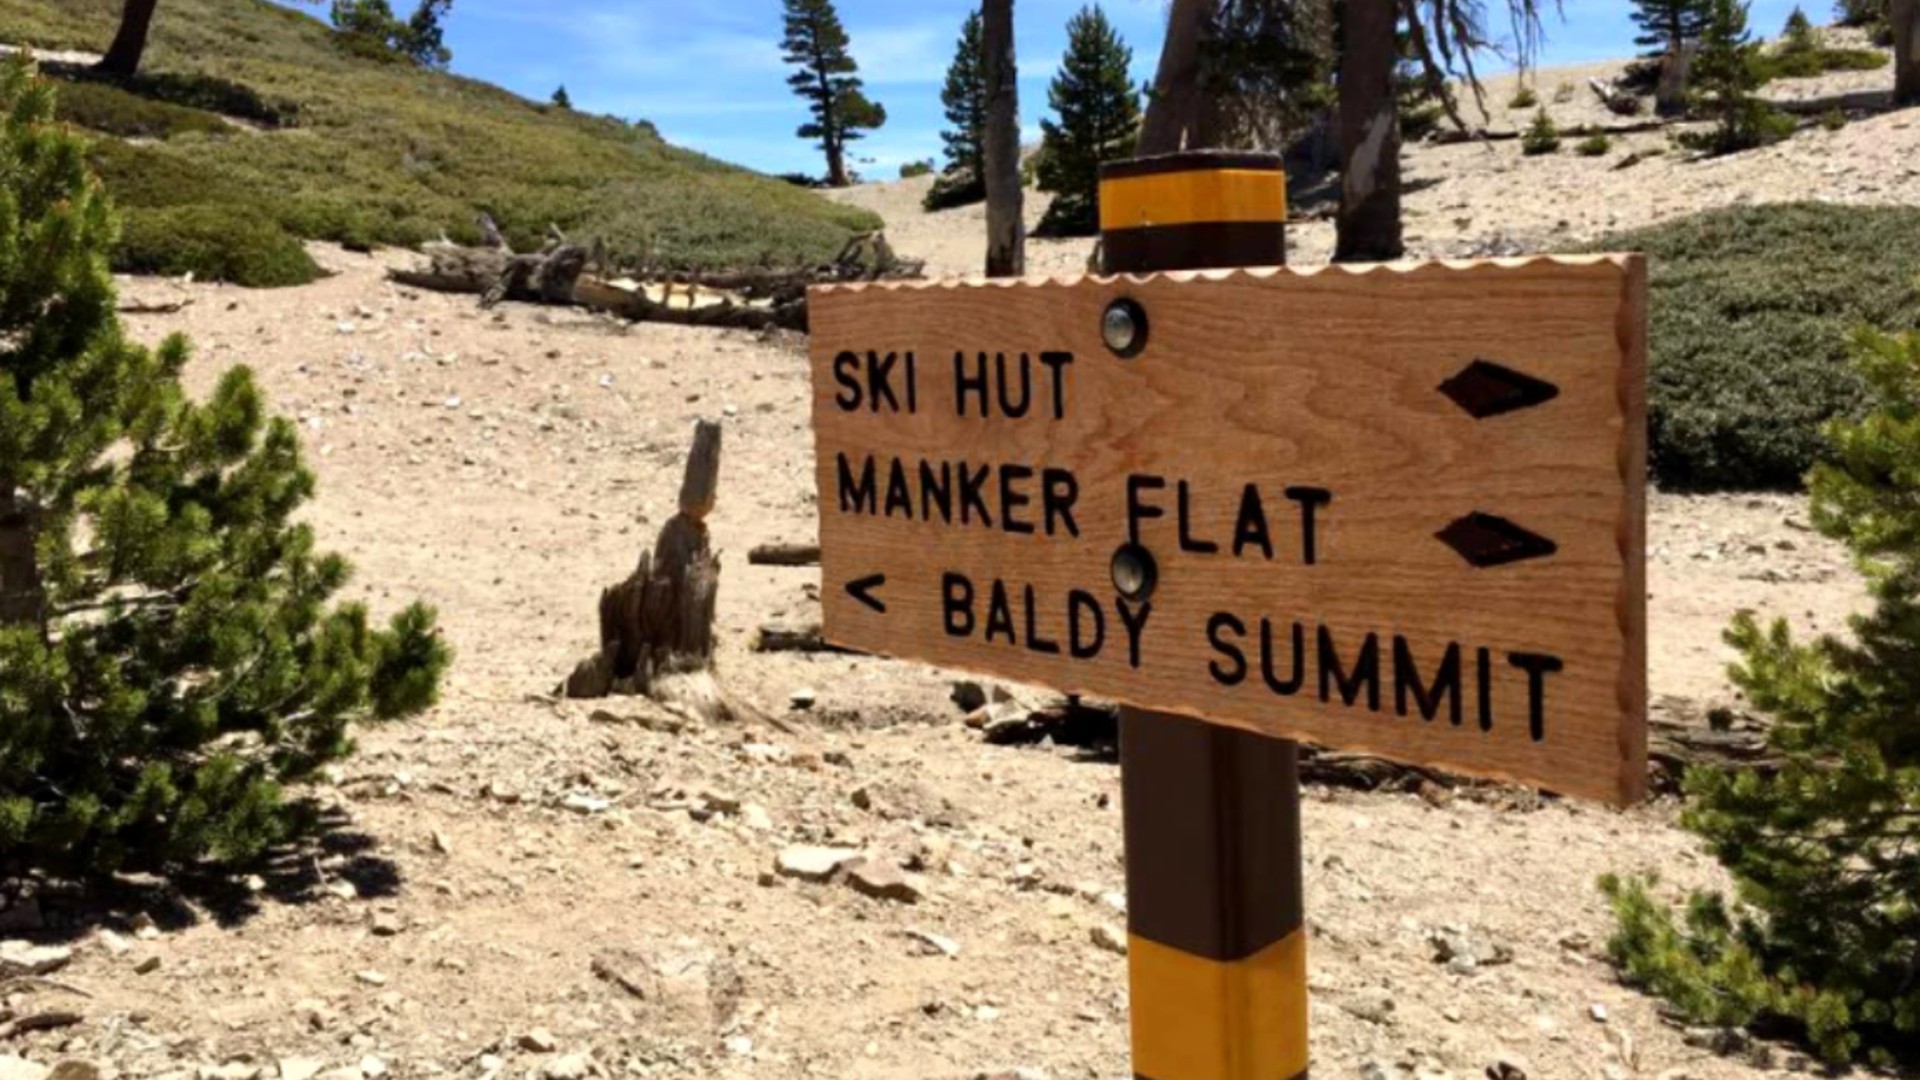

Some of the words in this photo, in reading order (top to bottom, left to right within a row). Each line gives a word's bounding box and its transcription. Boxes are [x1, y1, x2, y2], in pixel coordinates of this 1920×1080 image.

[832, 349, 917, 415] SKI
[952, 349, 1075, 422] HUT
[835, 451, 1081, 540] MANKER
[1126, 473, 1334, 567] FLAT
[940, 569, 1154, 670] BALDY
[1204, 610, 1567, 743] SUMMIT
